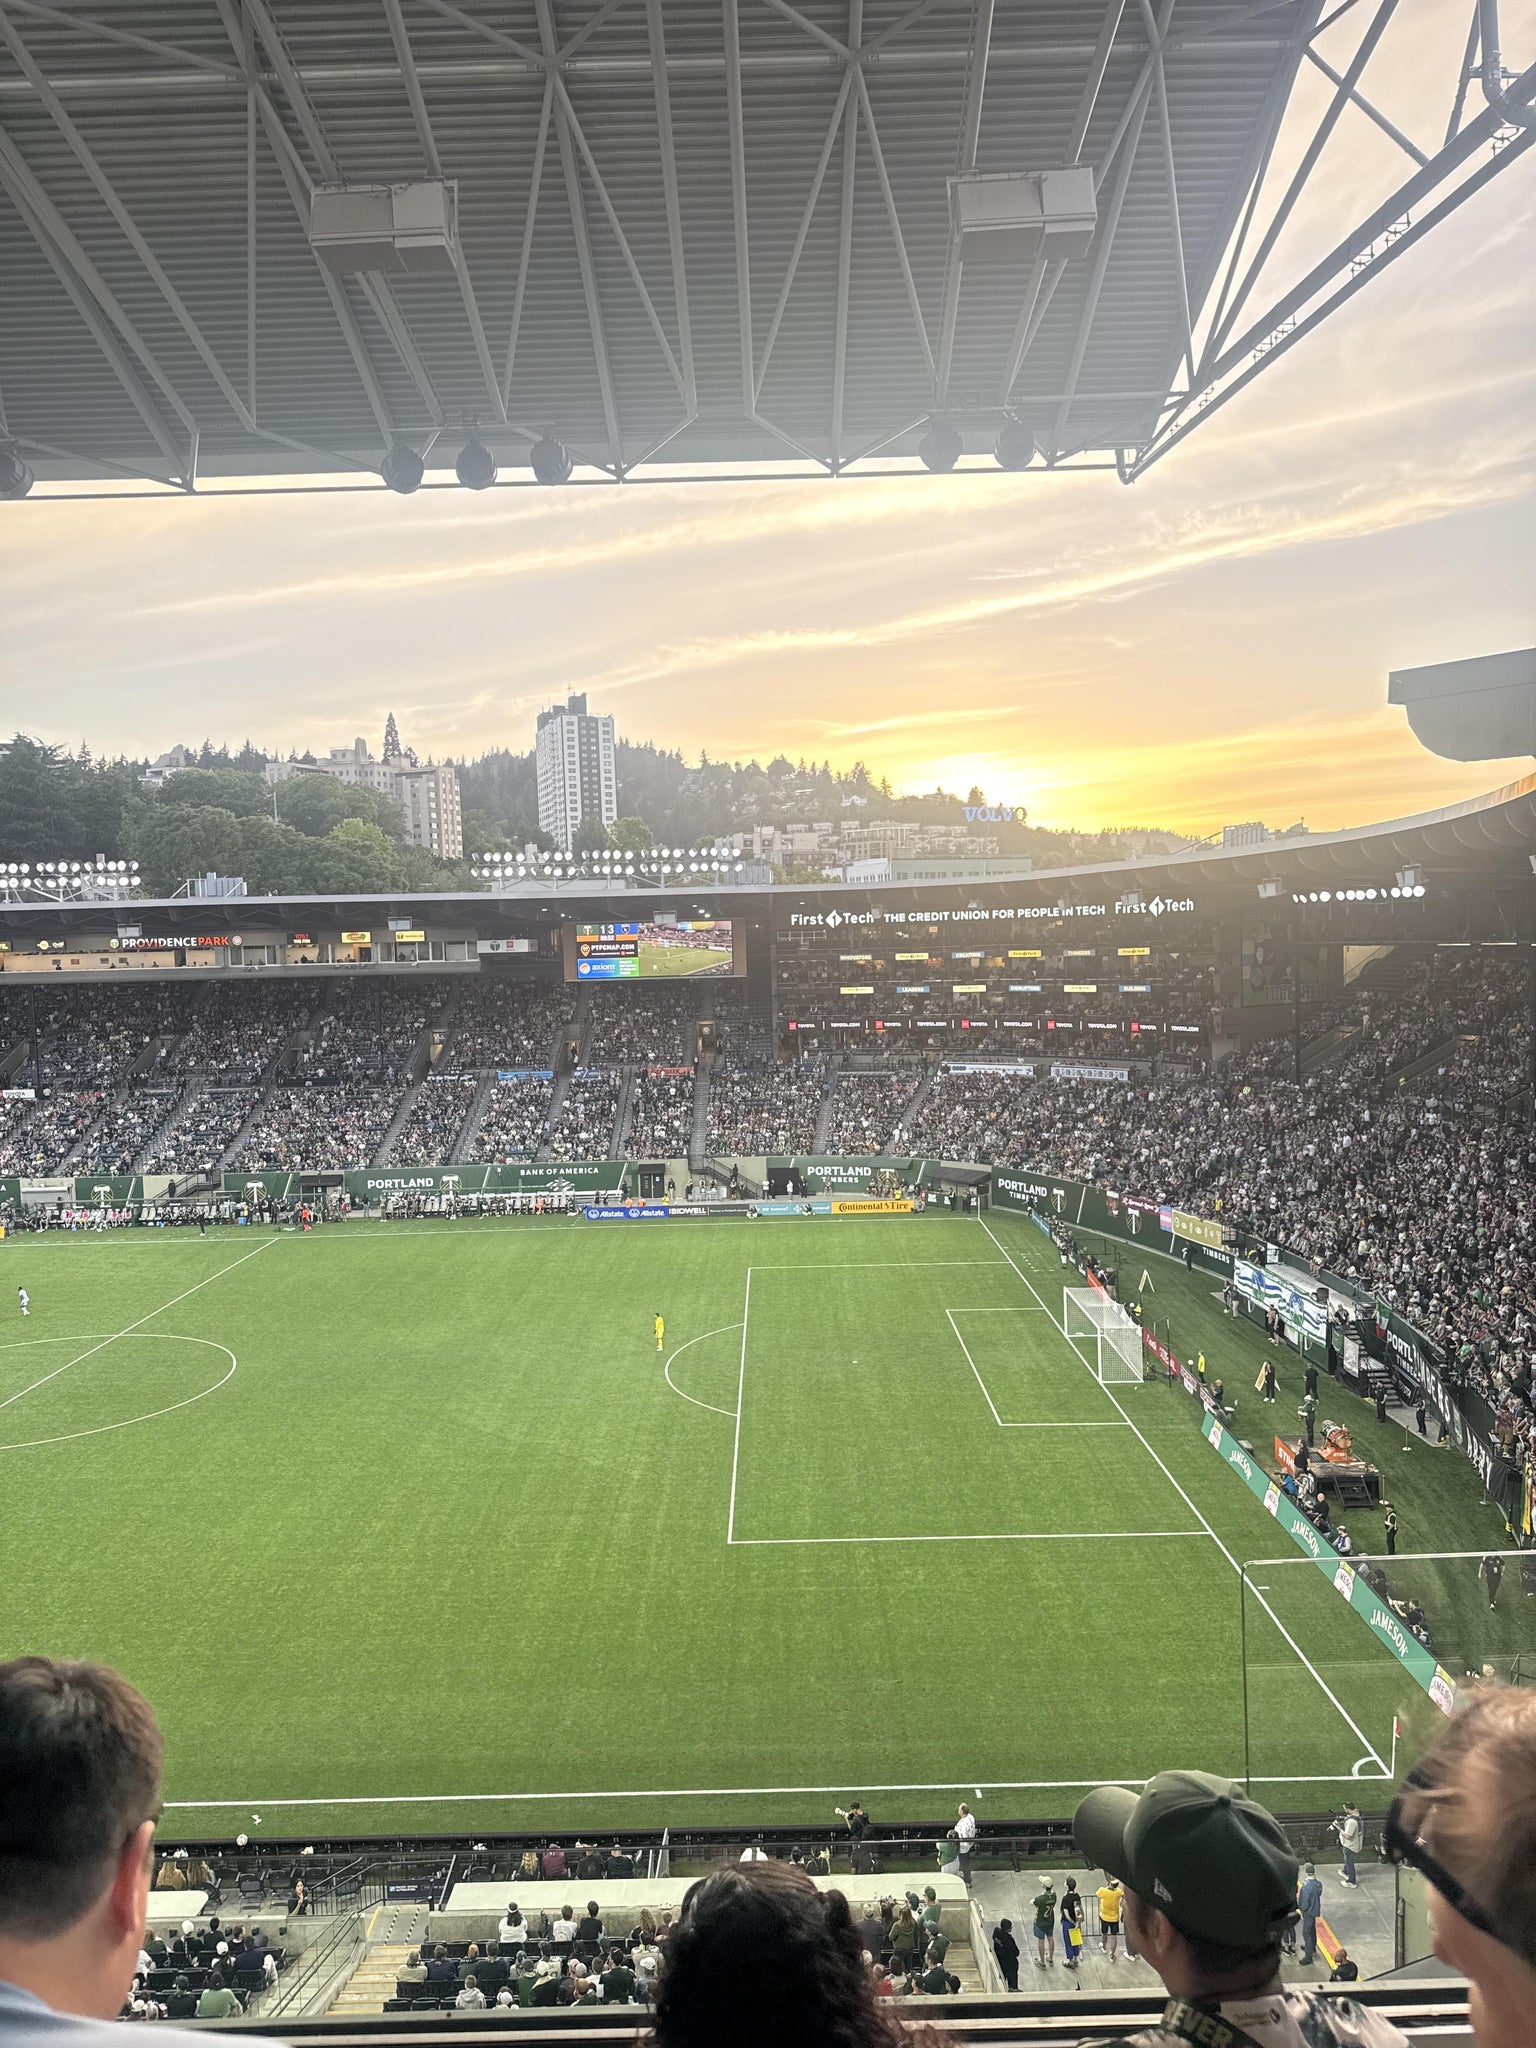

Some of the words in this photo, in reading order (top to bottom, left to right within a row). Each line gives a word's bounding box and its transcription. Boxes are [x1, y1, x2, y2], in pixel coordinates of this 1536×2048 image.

[962, 806, 1028, 822] VOLVO
[791, 914, 823, 925] First
[843, 912, 874, 924] Tech
[884, 913, 905, 923] THE
[908, 911, 950, 922] CREDIT
[952, 909, 990, 920] UNION
[992, 908, 1015, 919] FOR
[1017, 906, 1060, 918] PEOPLE
[1076, 904, 1106, 916] TECH
[1115, 901, 1146, 914] First
[1164, 898, 1194, 912] Tech
[600, 925, 605, 934] 1
[608, 925, 614, 934] 3
[807, 1166, 872, 1176] PORTLAND
[367, 1178, 434, 1189] PORTLAND
[998, 1178, 1048, 1197] PORTLAND
[600, 1210, 625, 1218] Allstate
[641, 1208, 665, 1217] Allstate
[671, 1207, 707, 1215] BIDWELL
[839, 1202, 883, 1212] Continental
[889, 1201, 909, 1210] Tire
[1202, 1246, 1231, 1264] TIMBERS
[1229, 1449, 1252, 1481] JAMESON
[1290, 1519, 1320, 1558] JAMESON
[1370, 1609, 1409, 1658] JAMESON
